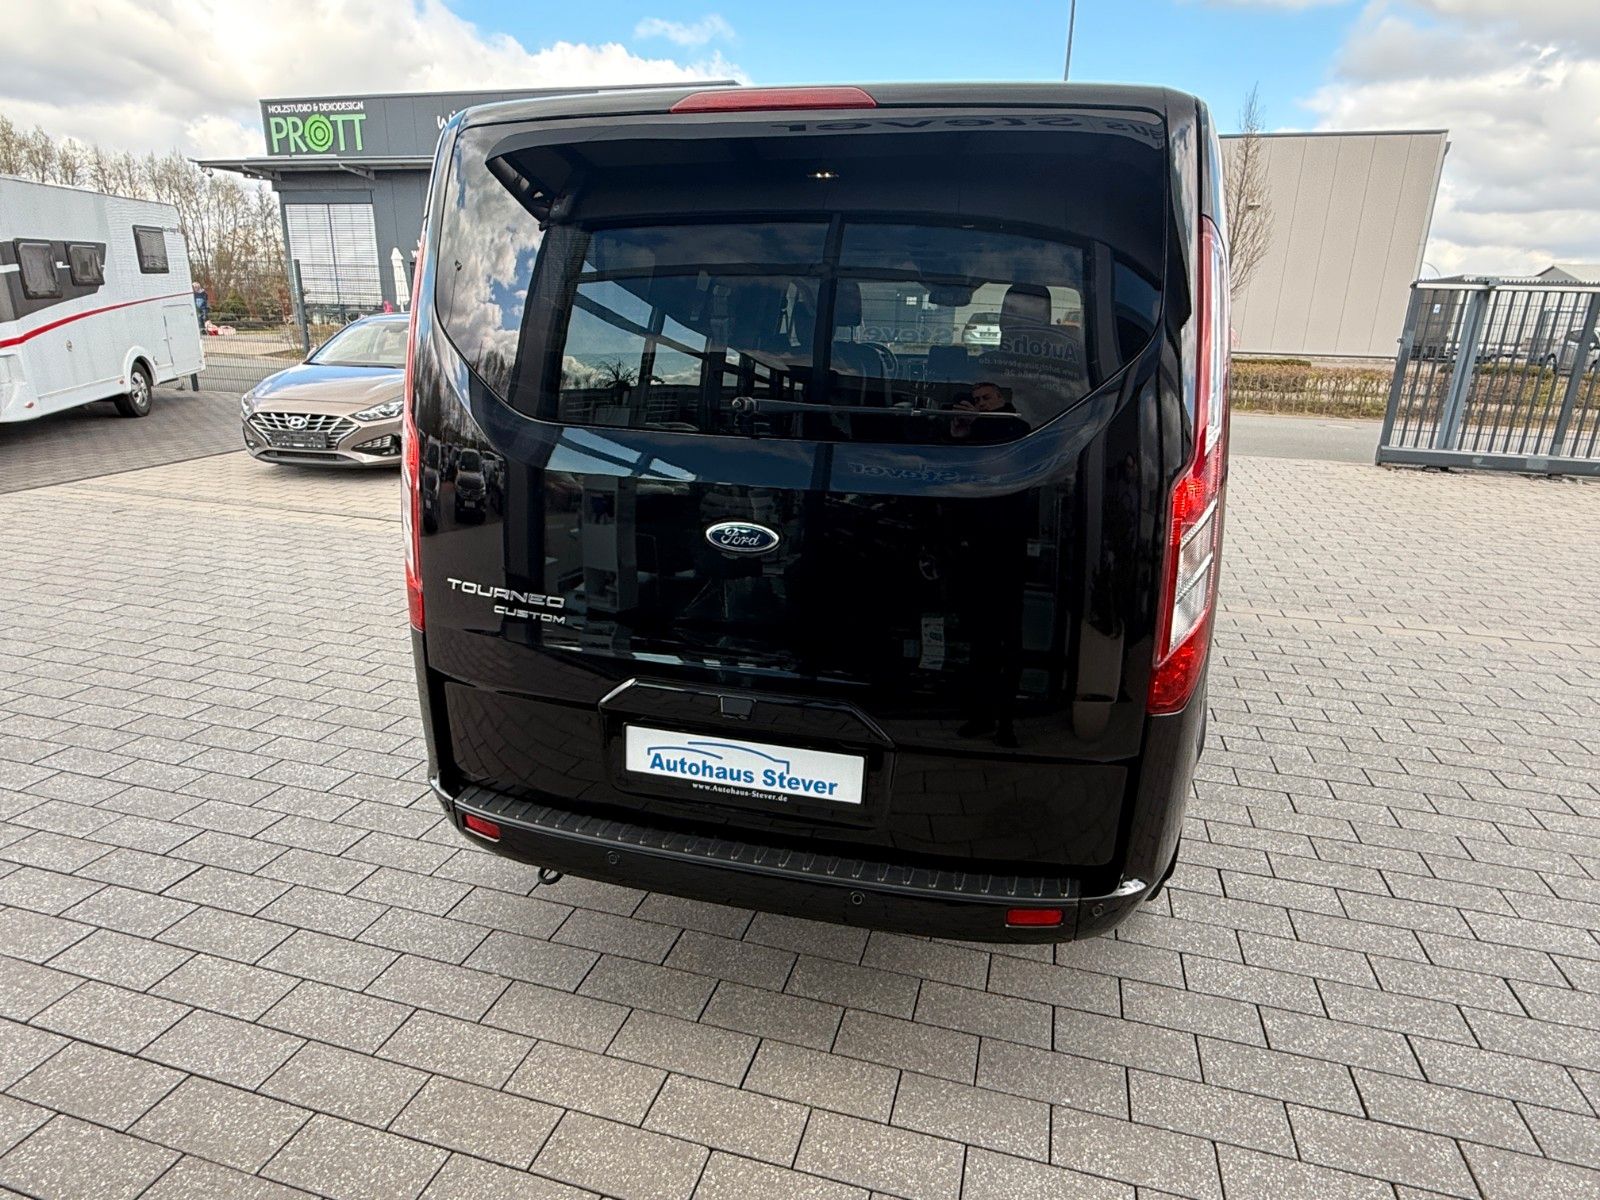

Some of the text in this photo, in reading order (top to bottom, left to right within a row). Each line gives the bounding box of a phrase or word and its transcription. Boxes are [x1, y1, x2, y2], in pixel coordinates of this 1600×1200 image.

[267, 101, 364, 114] HOLZSTUDIO & DEKODESIGN
[269, 113, 367, 153] PROTT
[721, 528, 761, 546] Ford
[447, 577, 565, 608] TOURNEO
[493, 605, 566, 624] CUSTOM
[650, 753, 838, 796] Autohaus Stever
[692, 782, 788, 802] www.Autohaus-Stever.de
